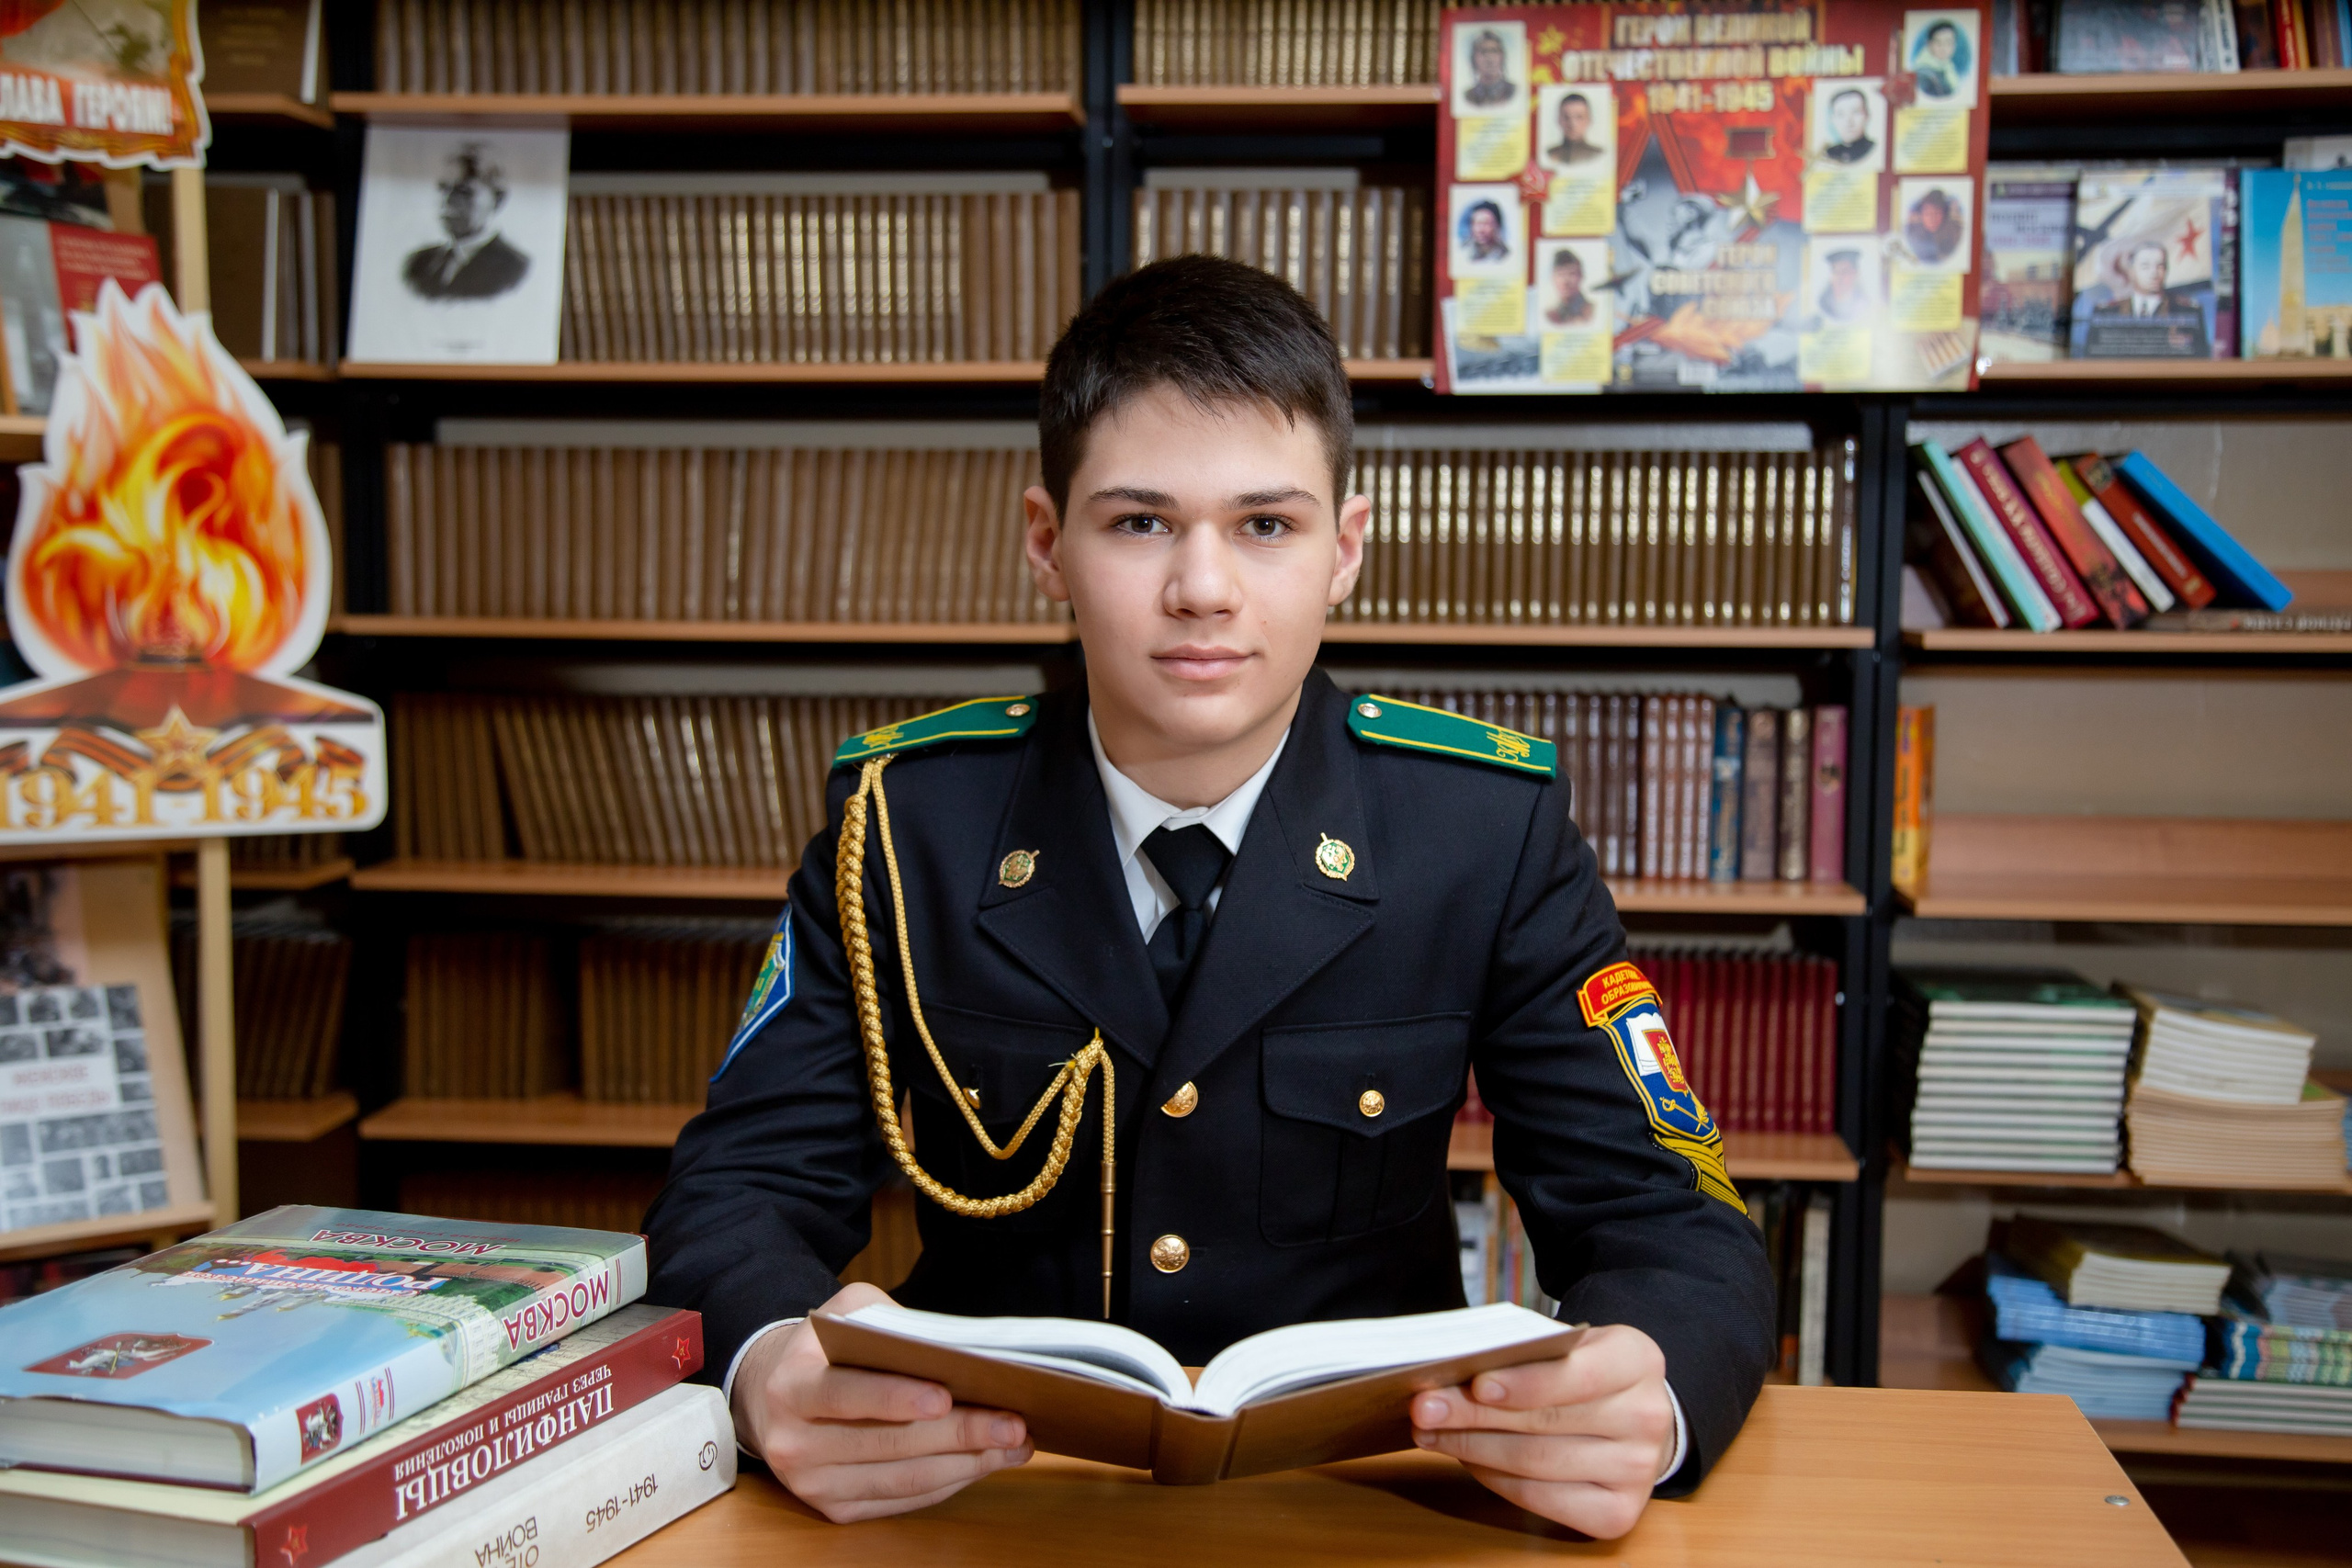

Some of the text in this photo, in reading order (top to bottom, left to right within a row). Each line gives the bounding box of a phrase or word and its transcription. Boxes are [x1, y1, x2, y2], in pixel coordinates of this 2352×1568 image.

[1614, 7, 1812, 46] ГЕРОИ ВЕЛИКОЙ
[1561, 41, 1866, 81] ОТЕЧЕСТВЕННОЙ ВОЙНЫ
[1645, 80, 1774, 114] 1941-1945
[307, 1229, 507, 1256] МОСКВА
[502, 1268, 611, 1353] МОСКВА
[394, 1364, 612, 1482] ЧЕРЕЗ ГРАНИЦЫ И ПОКОЛЕНИЯ
[395, 1383, 615, 1521] ПАНФИЛОВЦЫ
[585, 1472, 660, 1533] 1941-1945
[474, 1517, 538, 1568] ВОЙНА
